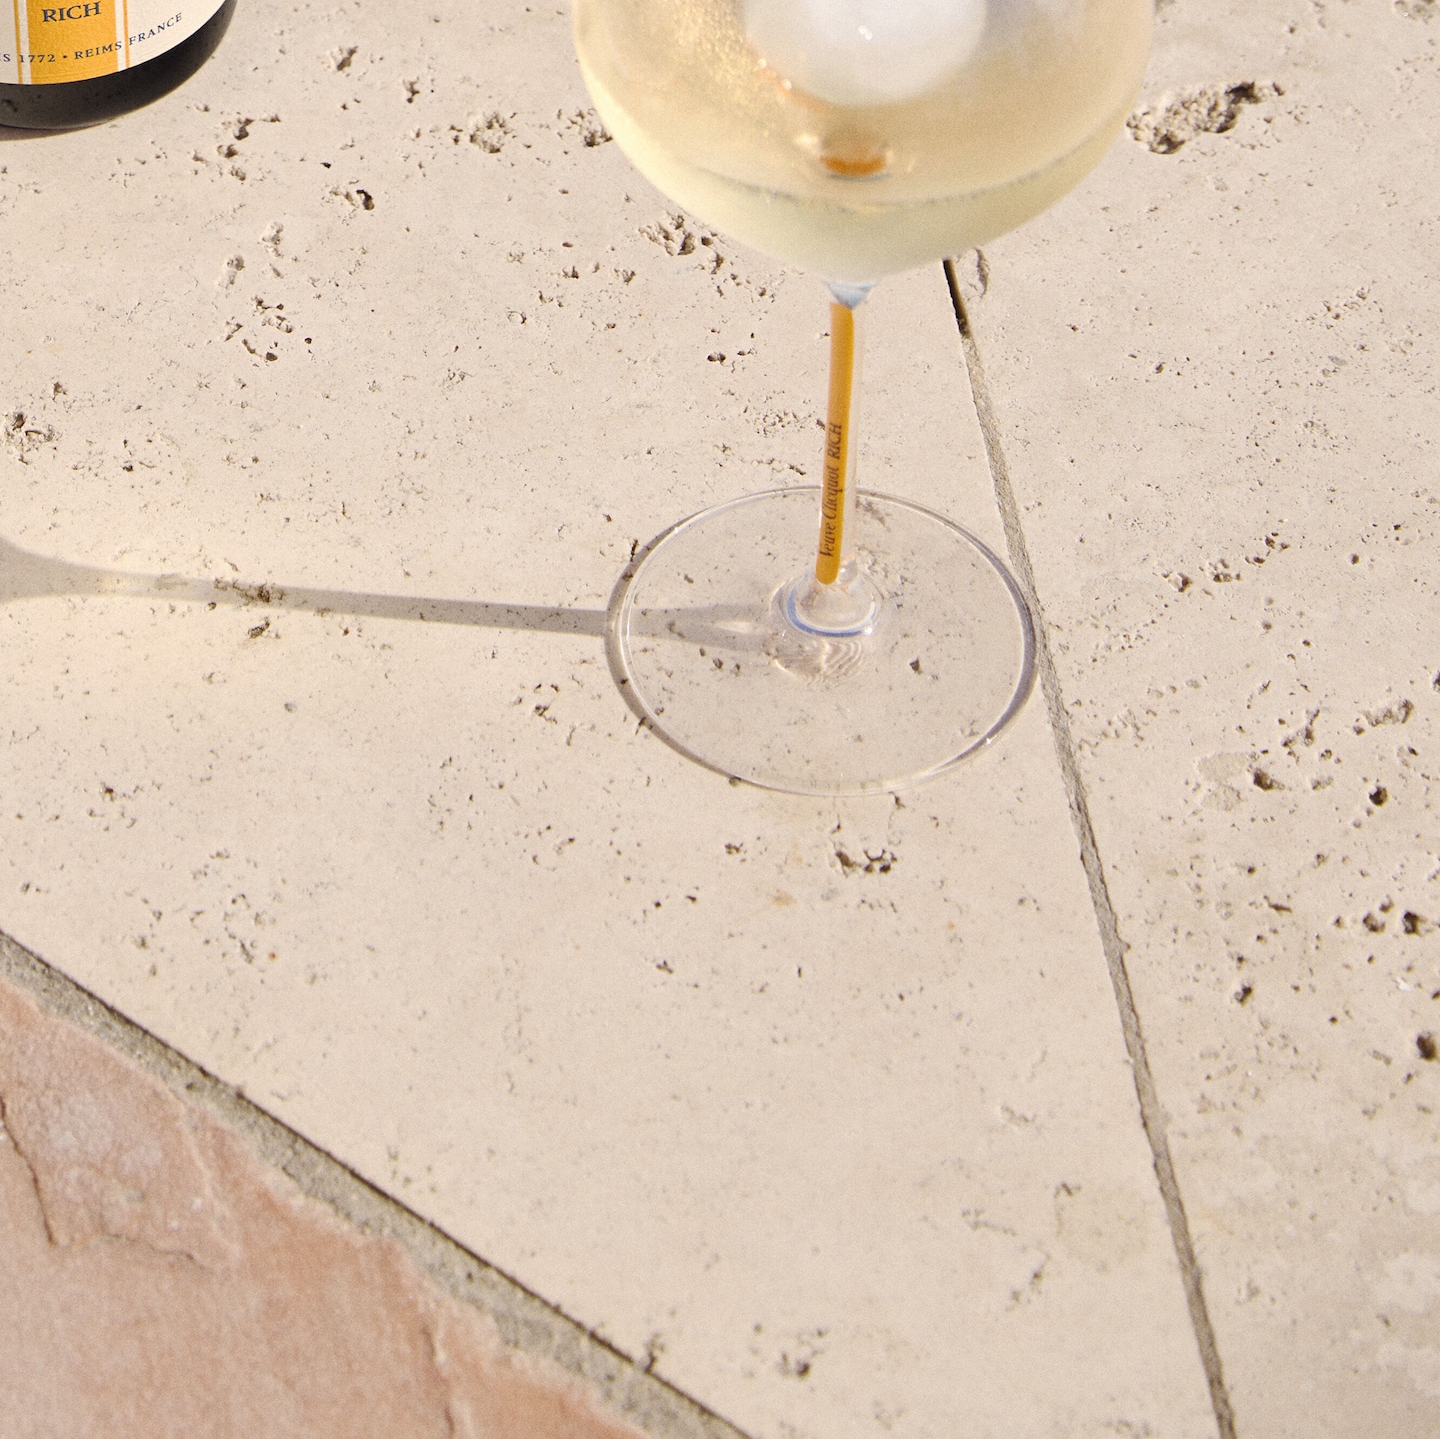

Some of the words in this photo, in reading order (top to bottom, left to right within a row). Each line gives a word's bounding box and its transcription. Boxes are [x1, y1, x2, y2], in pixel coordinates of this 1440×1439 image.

[42, 1, 101, 22] RICH
[19, 53, 56, 63] 1772
[74, 41, 122, 60] REIMS
[128, 12, 183, 45] FRANCE
[827, 422, 842, 460] RICH
[822, 465, 843, 520] Clicquot
[820, 522, 836, 557] Veuve
